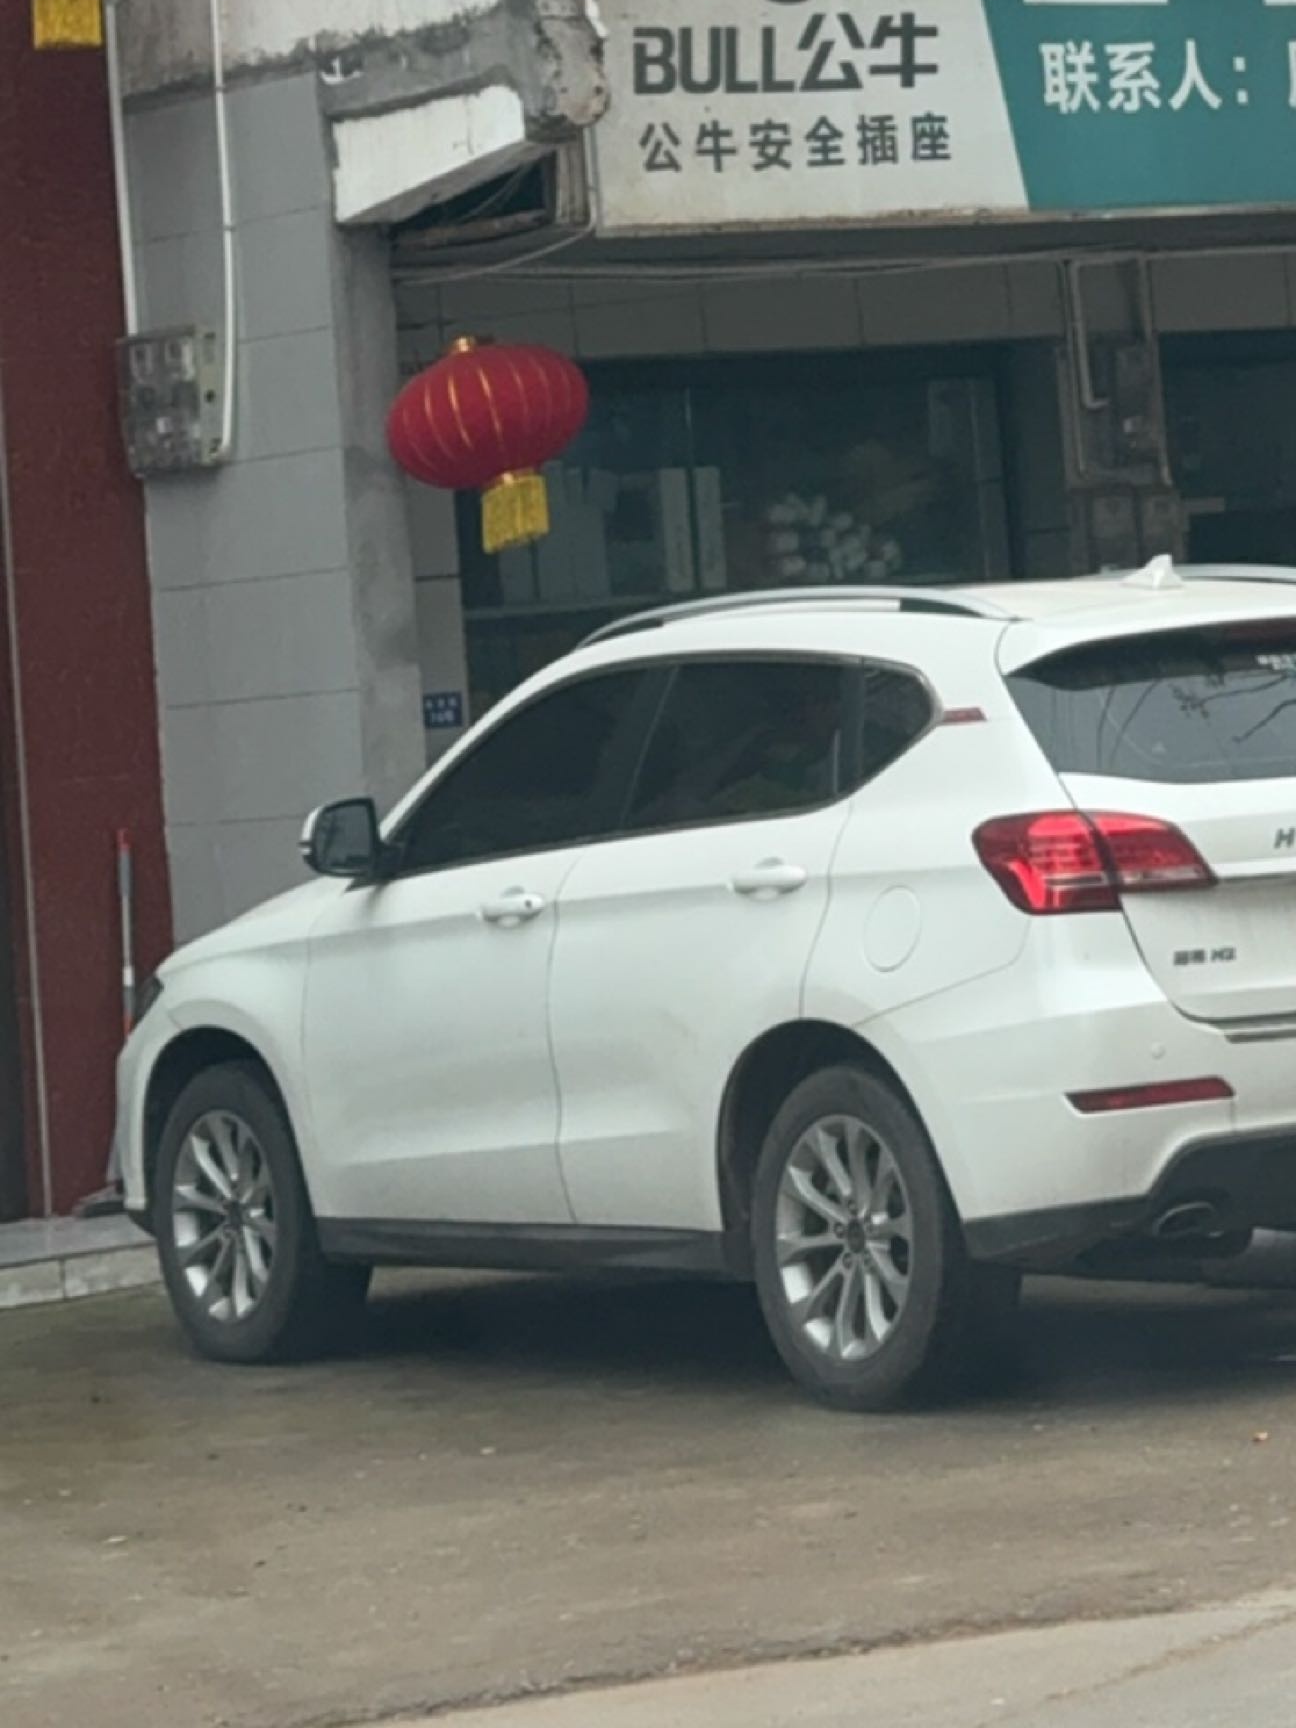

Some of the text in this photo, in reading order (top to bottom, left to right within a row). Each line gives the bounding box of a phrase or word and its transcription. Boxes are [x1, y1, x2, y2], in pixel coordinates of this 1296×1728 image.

[639, 112, 951, 173] 公牛安全插座
